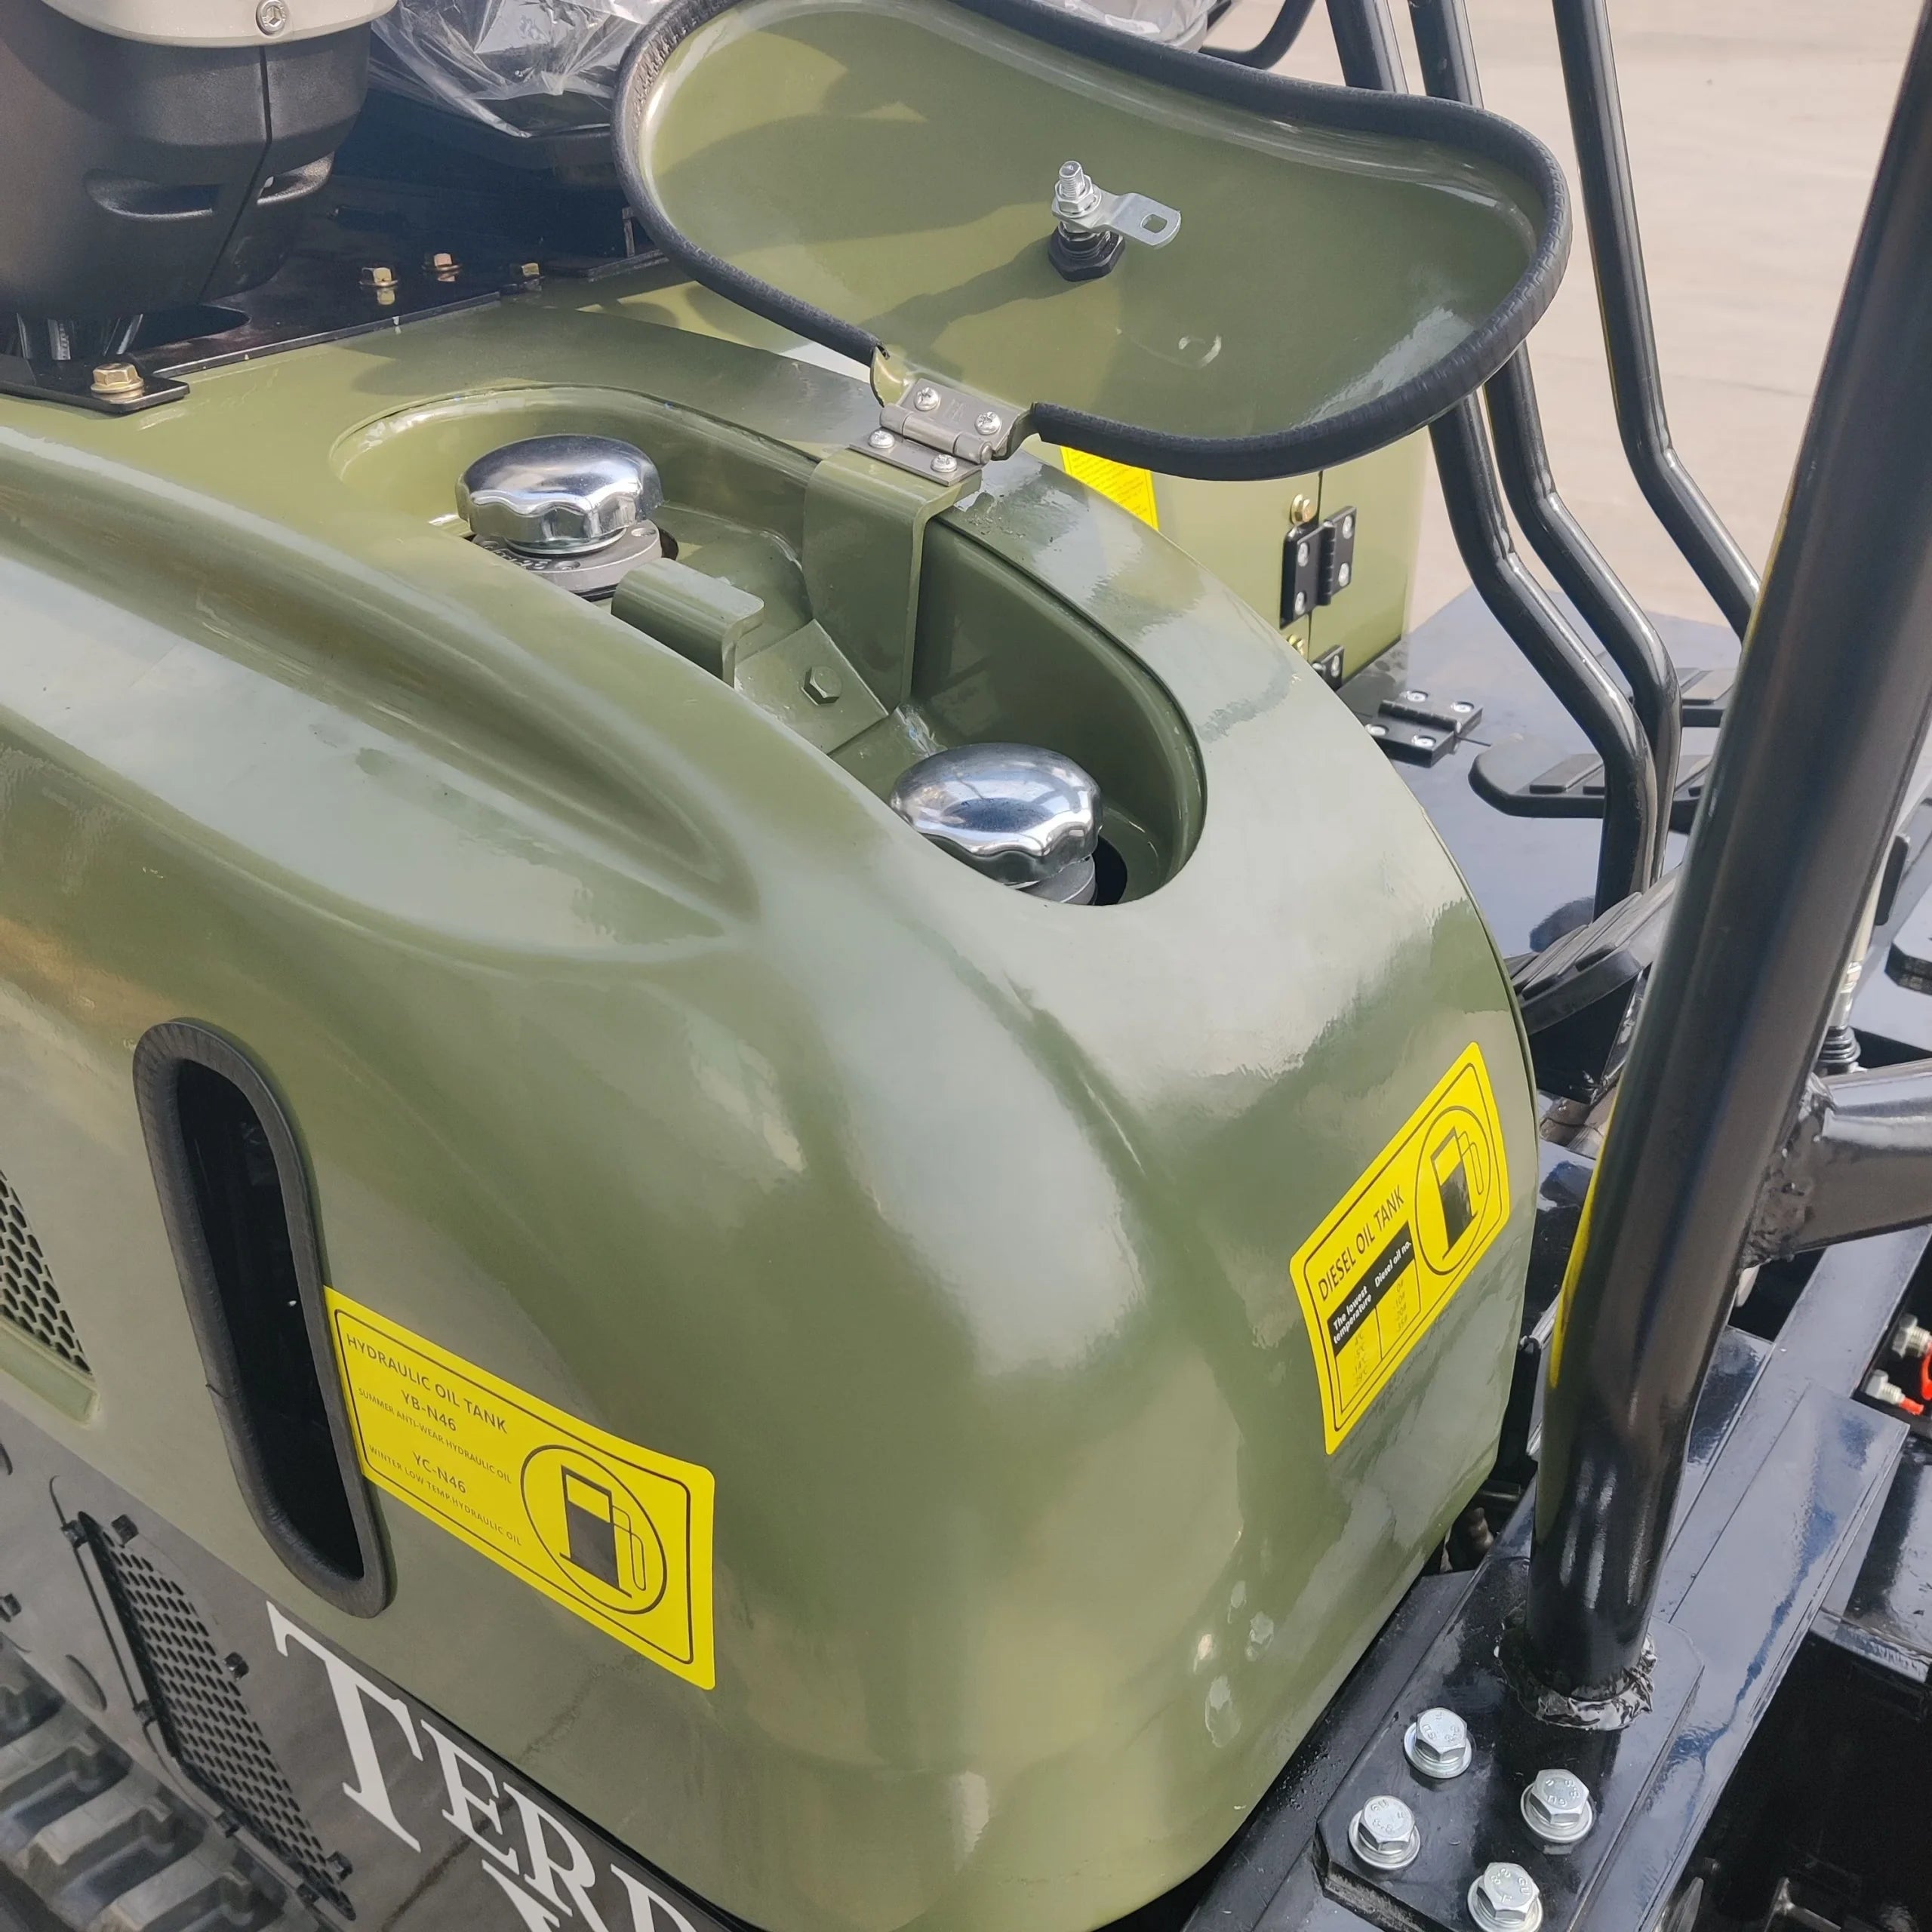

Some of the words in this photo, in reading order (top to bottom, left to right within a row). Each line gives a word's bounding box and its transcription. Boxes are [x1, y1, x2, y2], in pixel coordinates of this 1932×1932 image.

[1318, 1247, 1356, 1301] DIESEL
[1356, 1223, 1376, 1254] OIL
[1374, 1185, 1404, 1232] TANK
[1374, 1260, 1392, 1287] Diesel
[1393, 1251, 1401, 1265] oil
[1401, 1241, 1412, 1256] no.
[1334, 1313, 1346, 1331] The
[1346, 1285, 1367, 1316] lowest
[1334, 1294, 1372, 1344] temperature
[346, 1334, 431, 1391] HYDRAULIC
[435, 1383, 460, 1407] OIL
[463, 1398, 507, 1433] TANK
[401, 1389, 457, 1431] YB-N46
[358, 1388, 394, 1413] SUMMER
[397, 1410, 444, 1443] ANTI-WEAR
[446, 1438, 495, 1474] HYDRAULIC
[497, 1469, 512, 1484] OIL
[369, 1444, 402, 1470] WINTER
[405, 1467, 423, 1484] LOW
[506, 1531, 521, 1546] OIL
[413, 1451, 466, 1494] YC-N46
